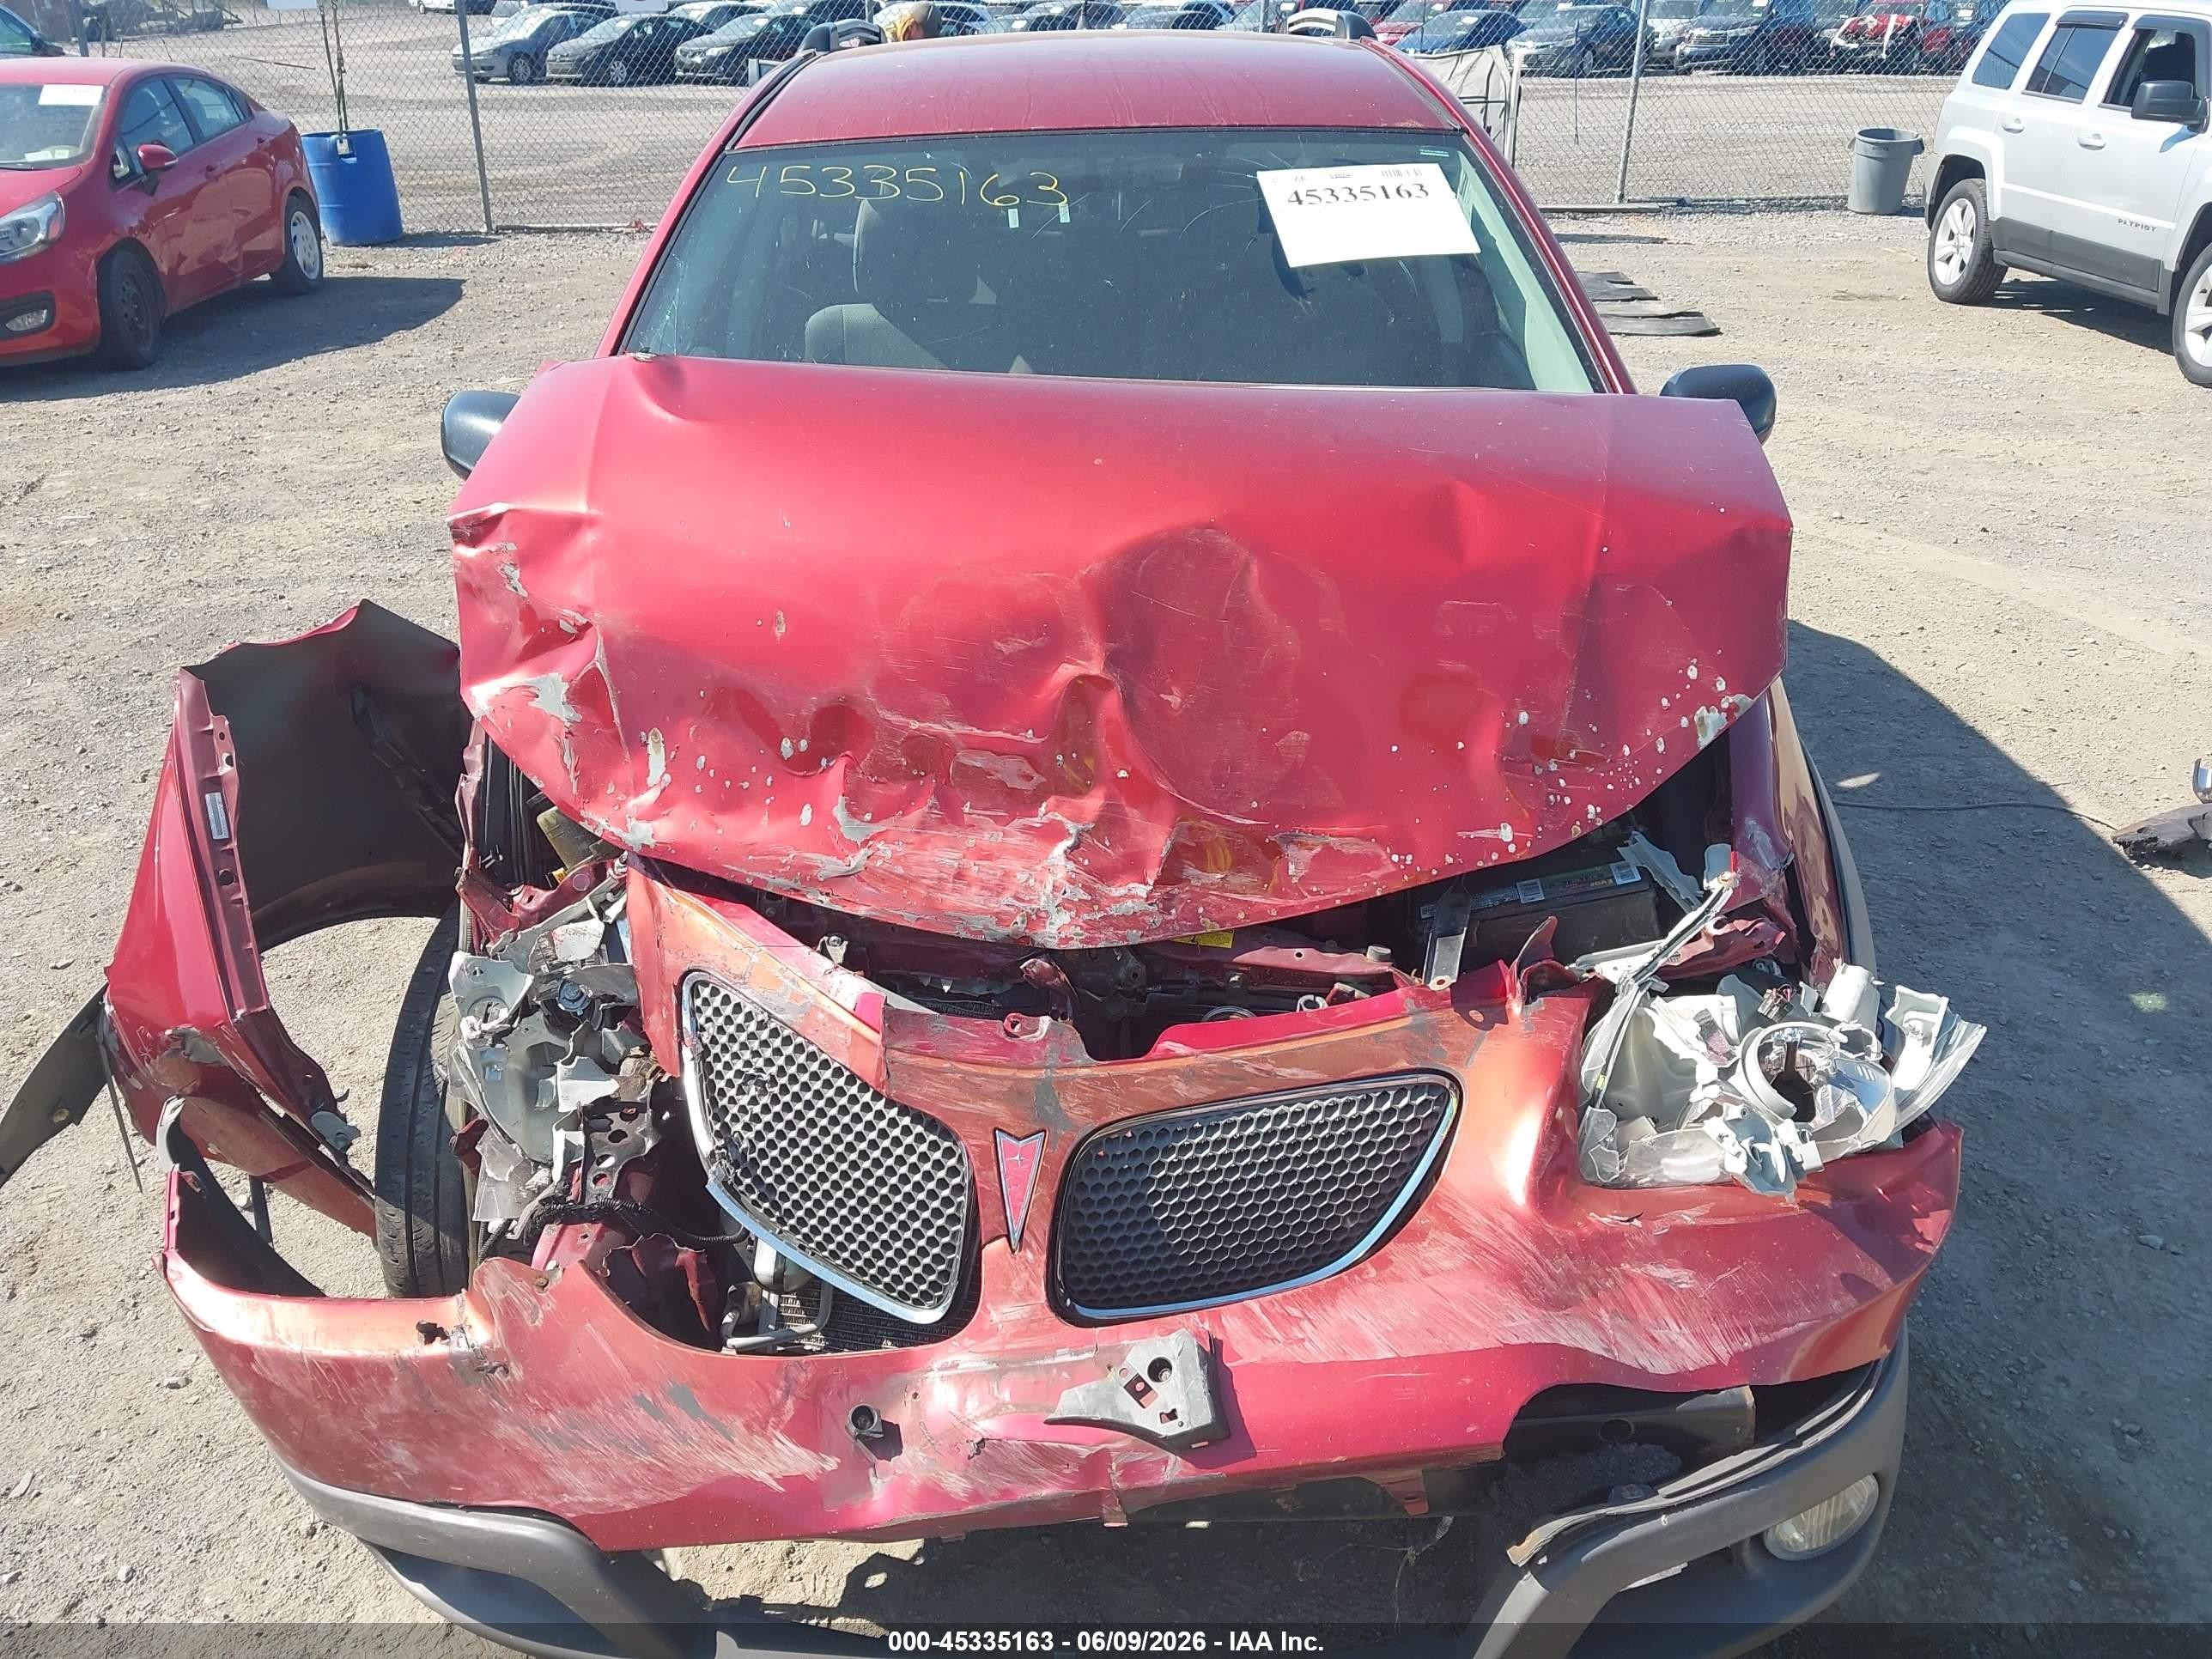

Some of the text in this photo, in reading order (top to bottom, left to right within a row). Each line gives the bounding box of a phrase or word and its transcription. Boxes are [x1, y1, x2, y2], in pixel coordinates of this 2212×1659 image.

[726, 164, 1069, 207] 45335163
[1287, 183, 1430, 206] 45335163
[2117, 218, 2157, 232] PATRIOT
